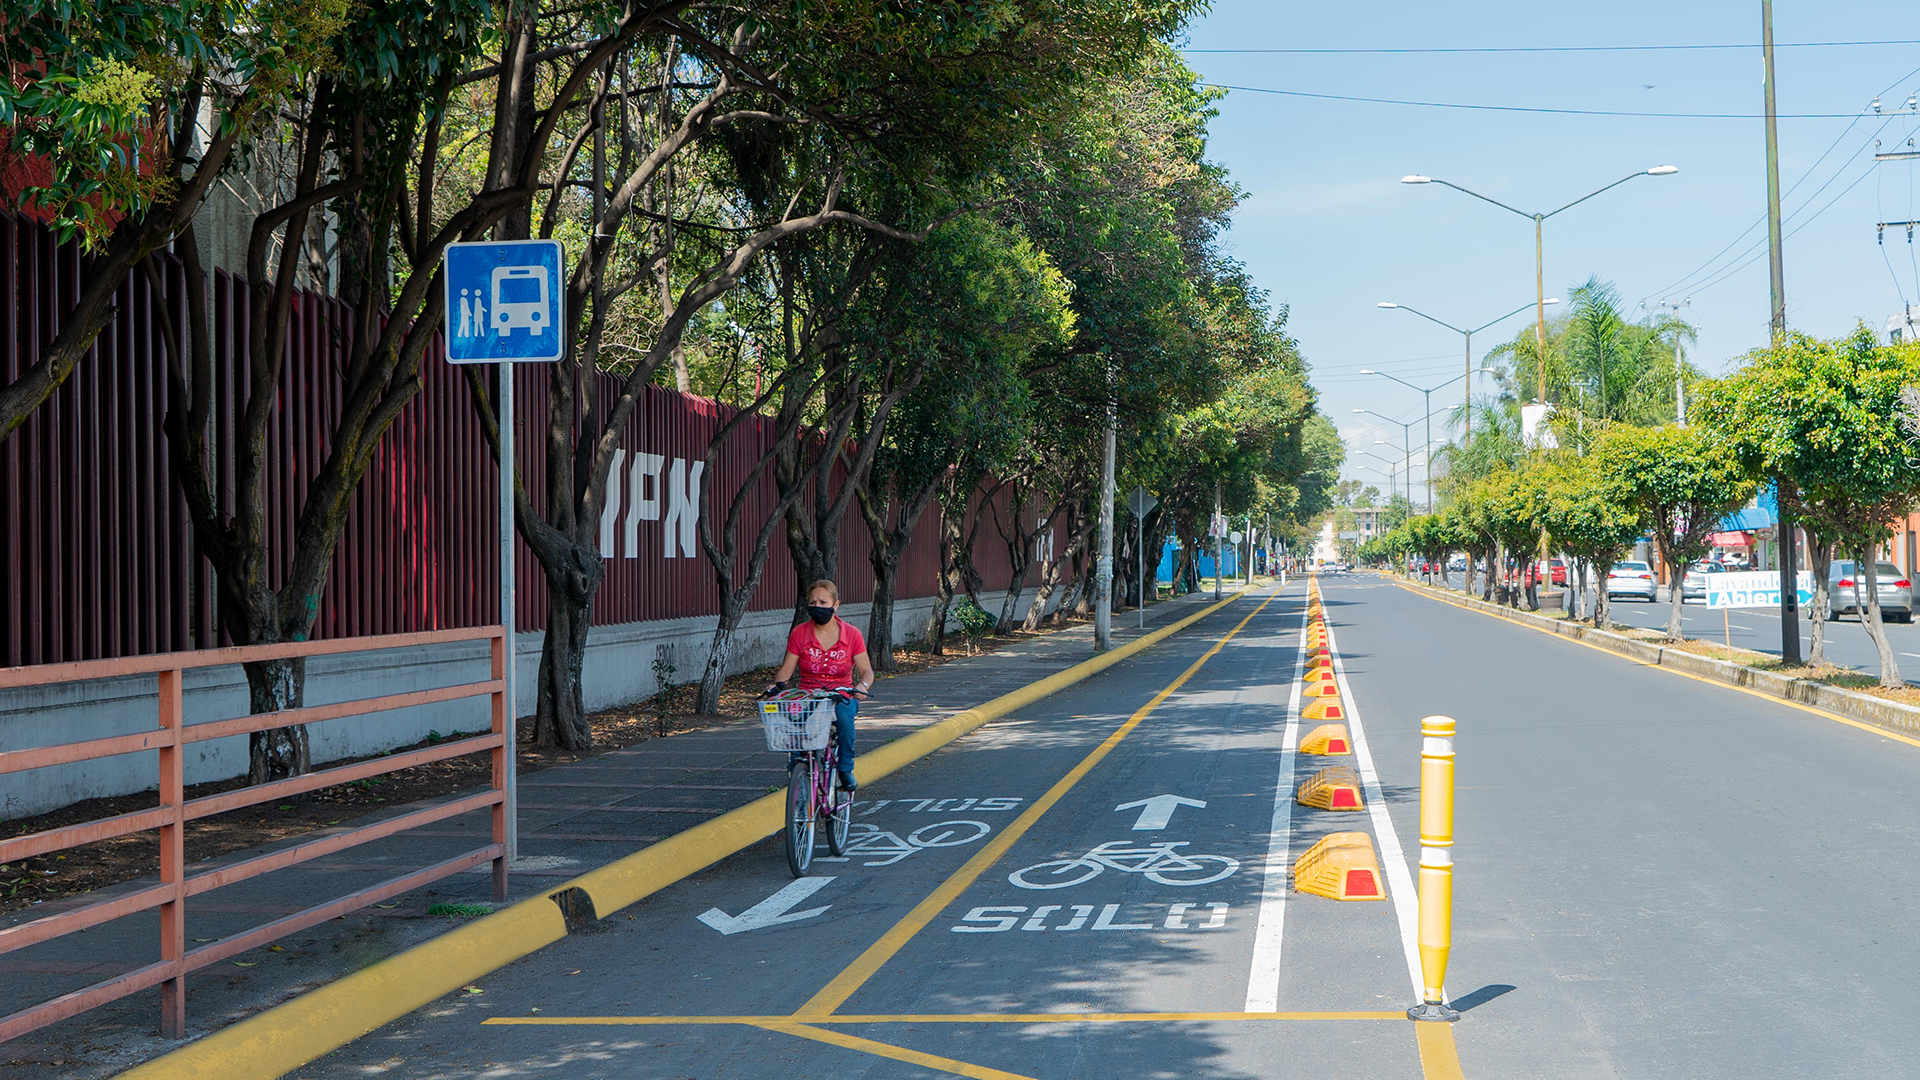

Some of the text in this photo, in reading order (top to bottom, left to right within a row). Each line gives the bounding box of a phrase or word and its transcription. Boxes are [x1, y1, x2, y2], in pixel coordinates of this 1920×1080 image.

[600, 448, 704, 559] IPN
[1708, 573, 1809, 590] Lavanda
[1714, 590, 1801, 605] Abier
[950, 902, 1229, 933] SOLO
